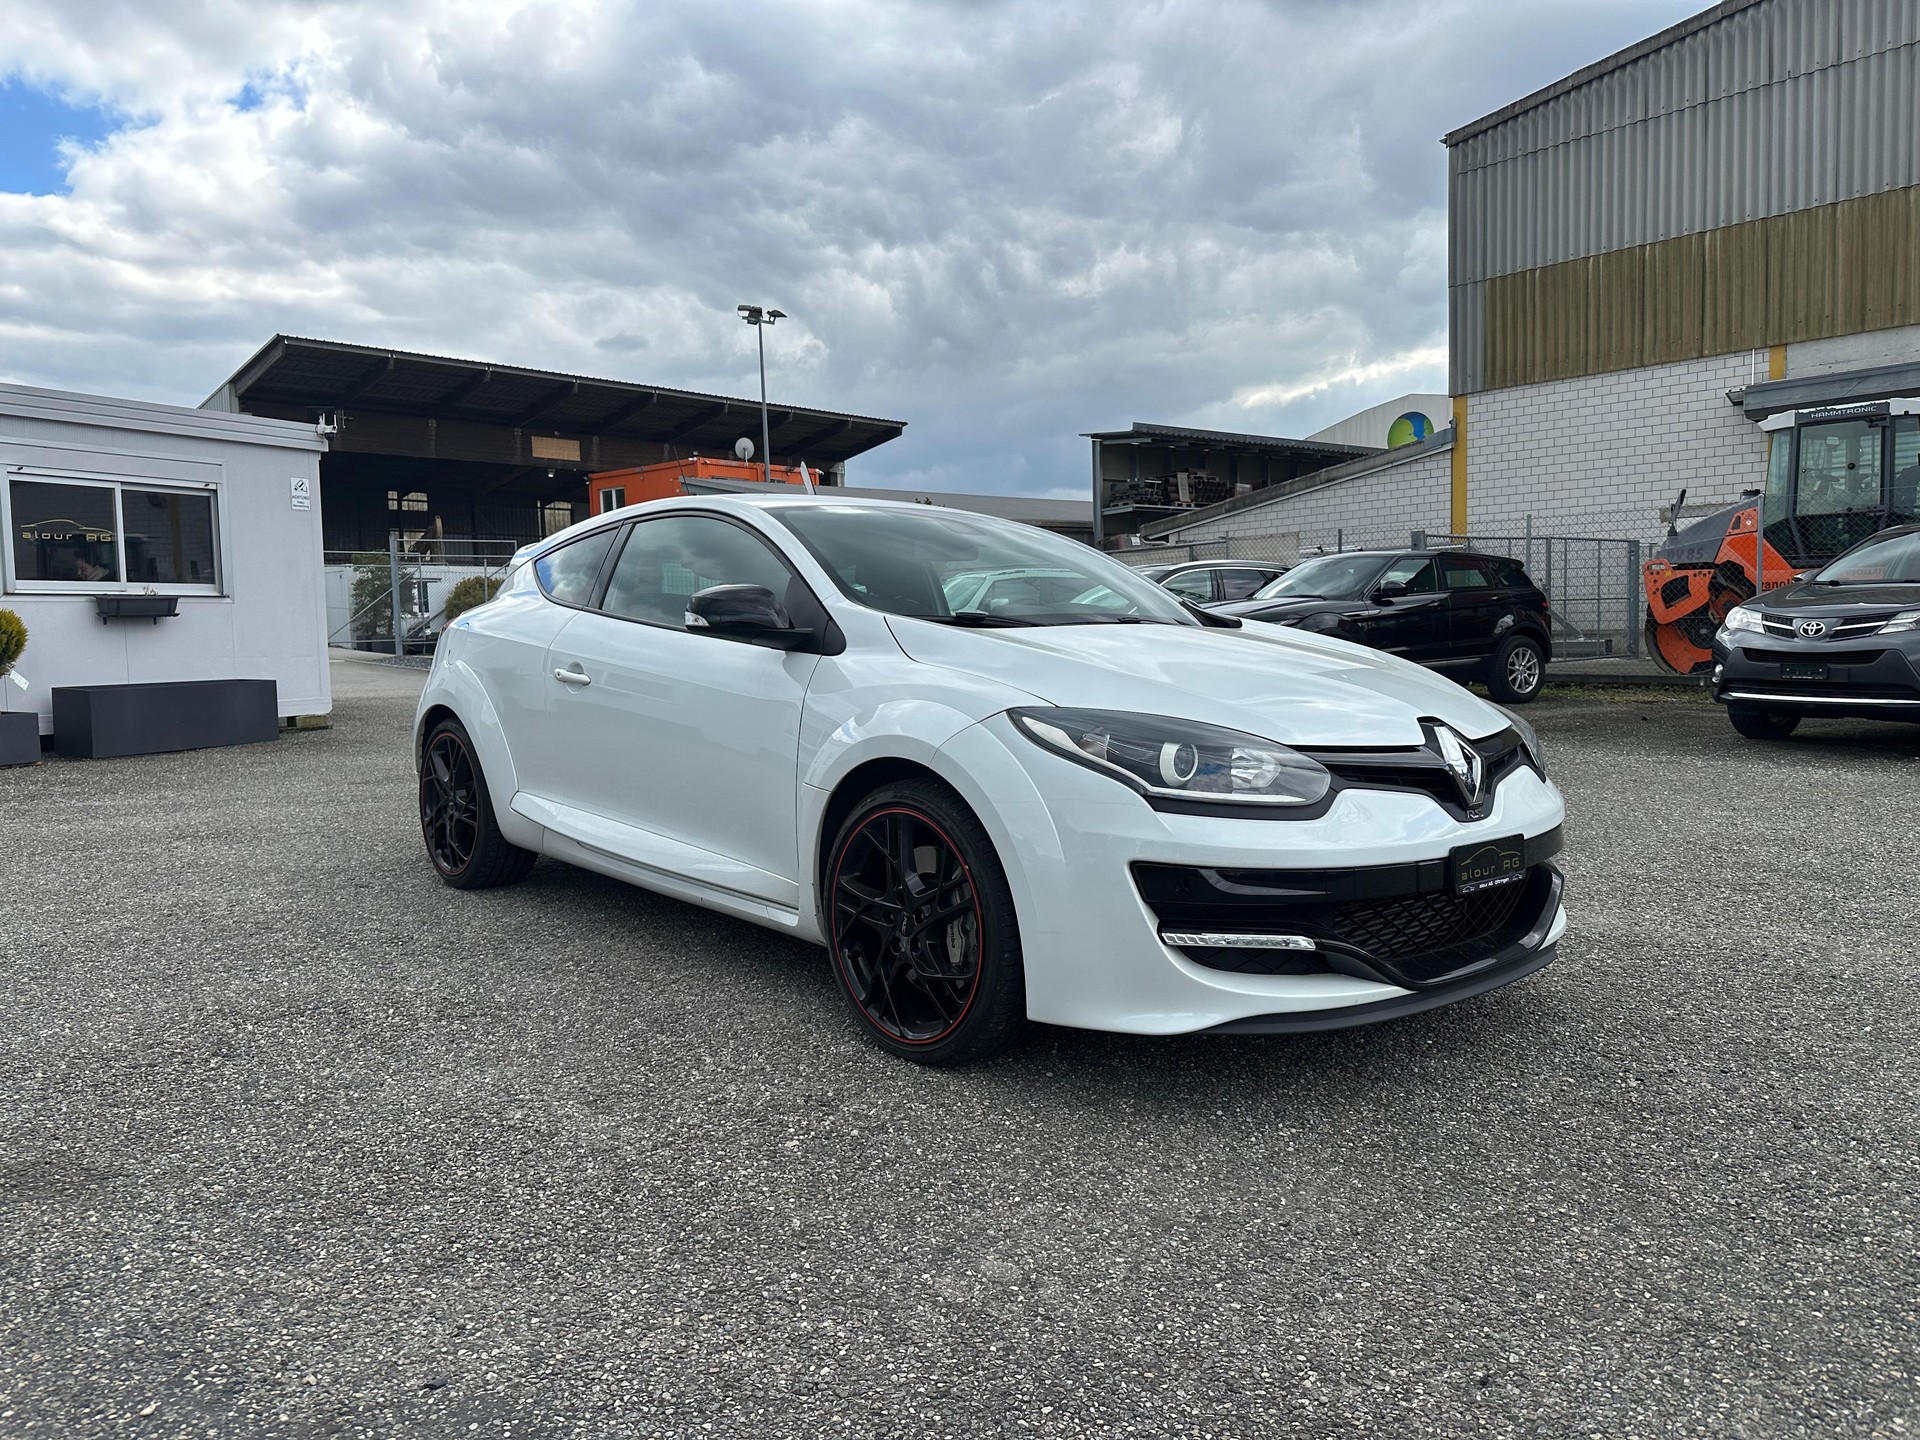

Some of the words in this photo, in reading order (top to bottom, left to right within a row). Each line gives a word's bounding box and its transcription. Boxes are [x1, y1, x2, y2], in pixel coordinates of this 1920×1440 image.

[1811, 406, 1877, 418] HAMMTRONIC
[22, 530, 73, 540] alour
[86, 533, 112, 542] AG
[1686, 548, 1705, 560] 85
[1461, 866, 1496, 880] alour
[1503, 857, 1520, 870] AG
